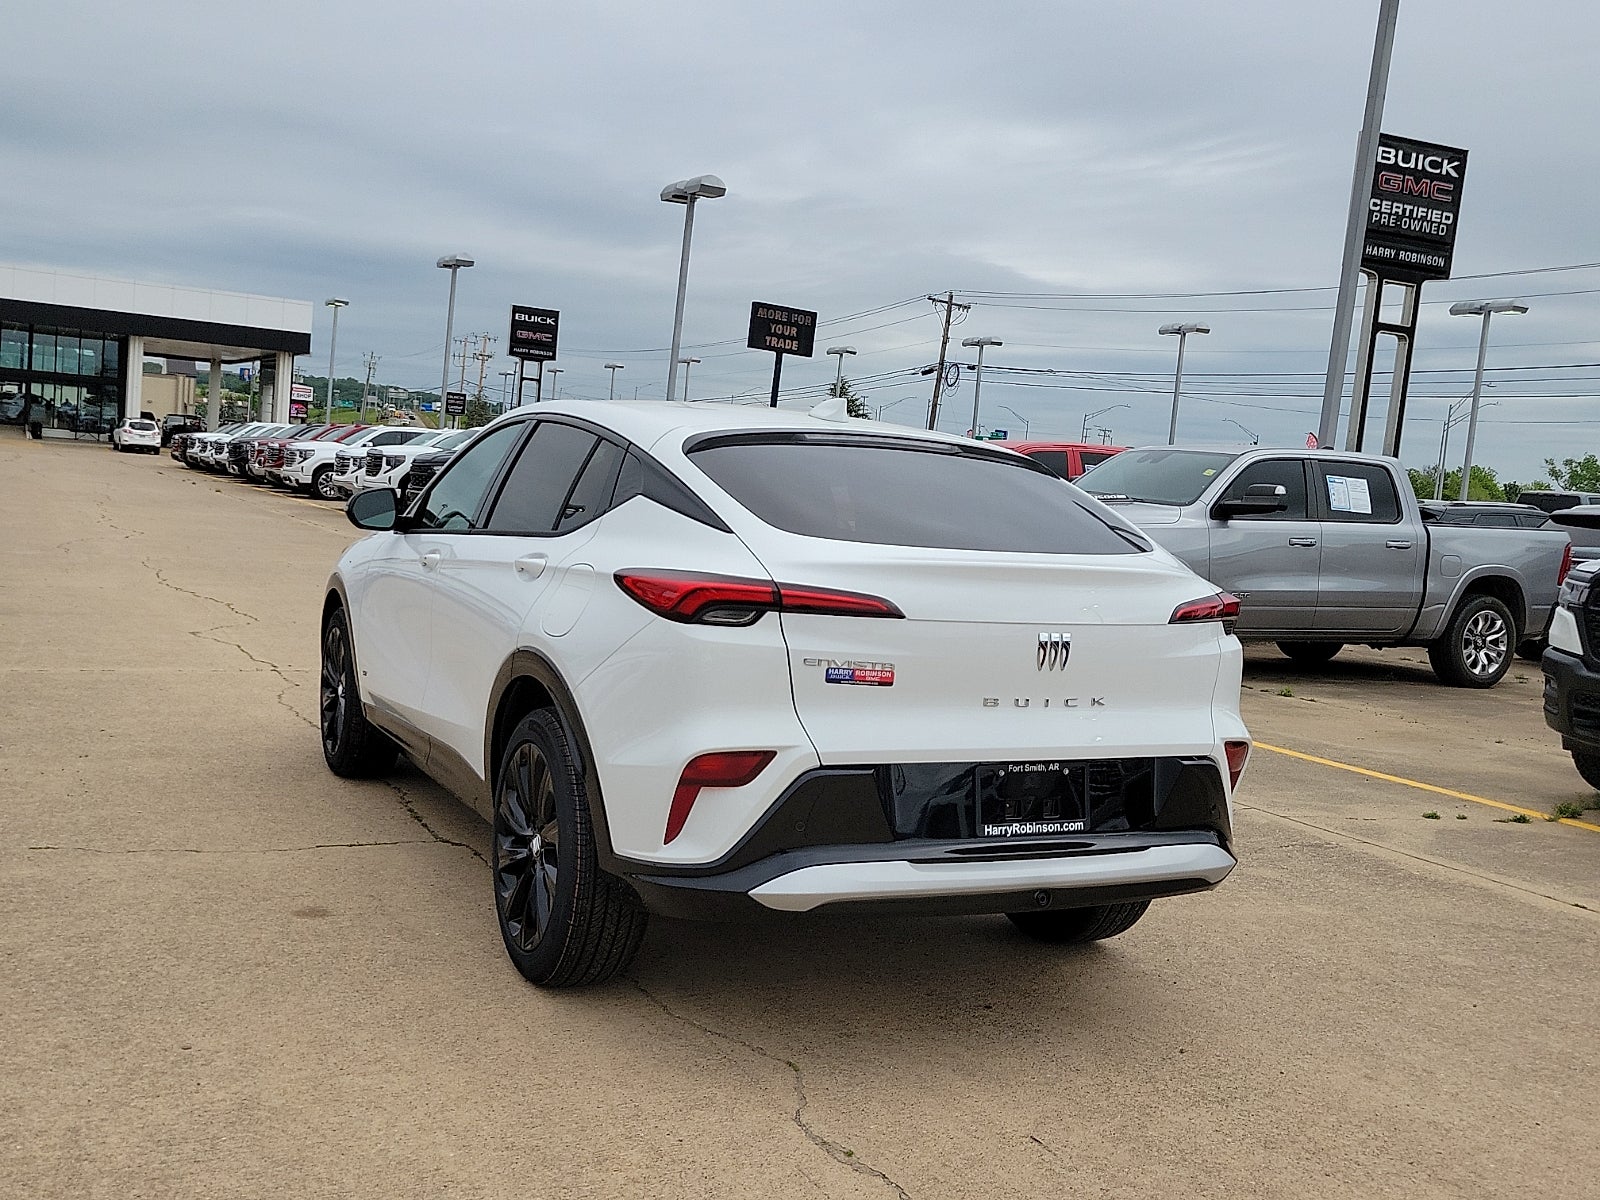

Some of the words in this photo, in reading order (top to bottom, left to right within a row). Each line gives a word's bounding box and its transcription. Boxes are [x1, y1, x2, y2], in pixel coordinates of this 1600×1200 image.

[1376, 146, 1461, 178] BUICK
[1378, 171, 1454, 202] GMC
[1369, 198, 1454, 225] CERTIFIED
[1371, 212, 1447, 236] PRE-OWNED
[1365, 244, 1397, 259] HARRY
[1398, 250, 1445, 267] ROBINSON
[514, 312, 556, 325] BUICK
[757, 307, 788, 322] MORE
[791, 313, 812, 326] FOR
[516, 329, 553, 342] GMC
[769, 322, 798, 337] YOUR
[765, 335, 799, 351] TRADE
[828, 668, 854, 676] HARRY
[855, 670, 892, 678] ROBINSON
[982, 697, 1106, 708] BUICK
[1008, 764, 1023, 773] Fort
[1024, 763, 1047, 773] Smith,
[1048, 762, 1060, 771] AR
[984, 821, 1084, 838] HarryRobinson.com
